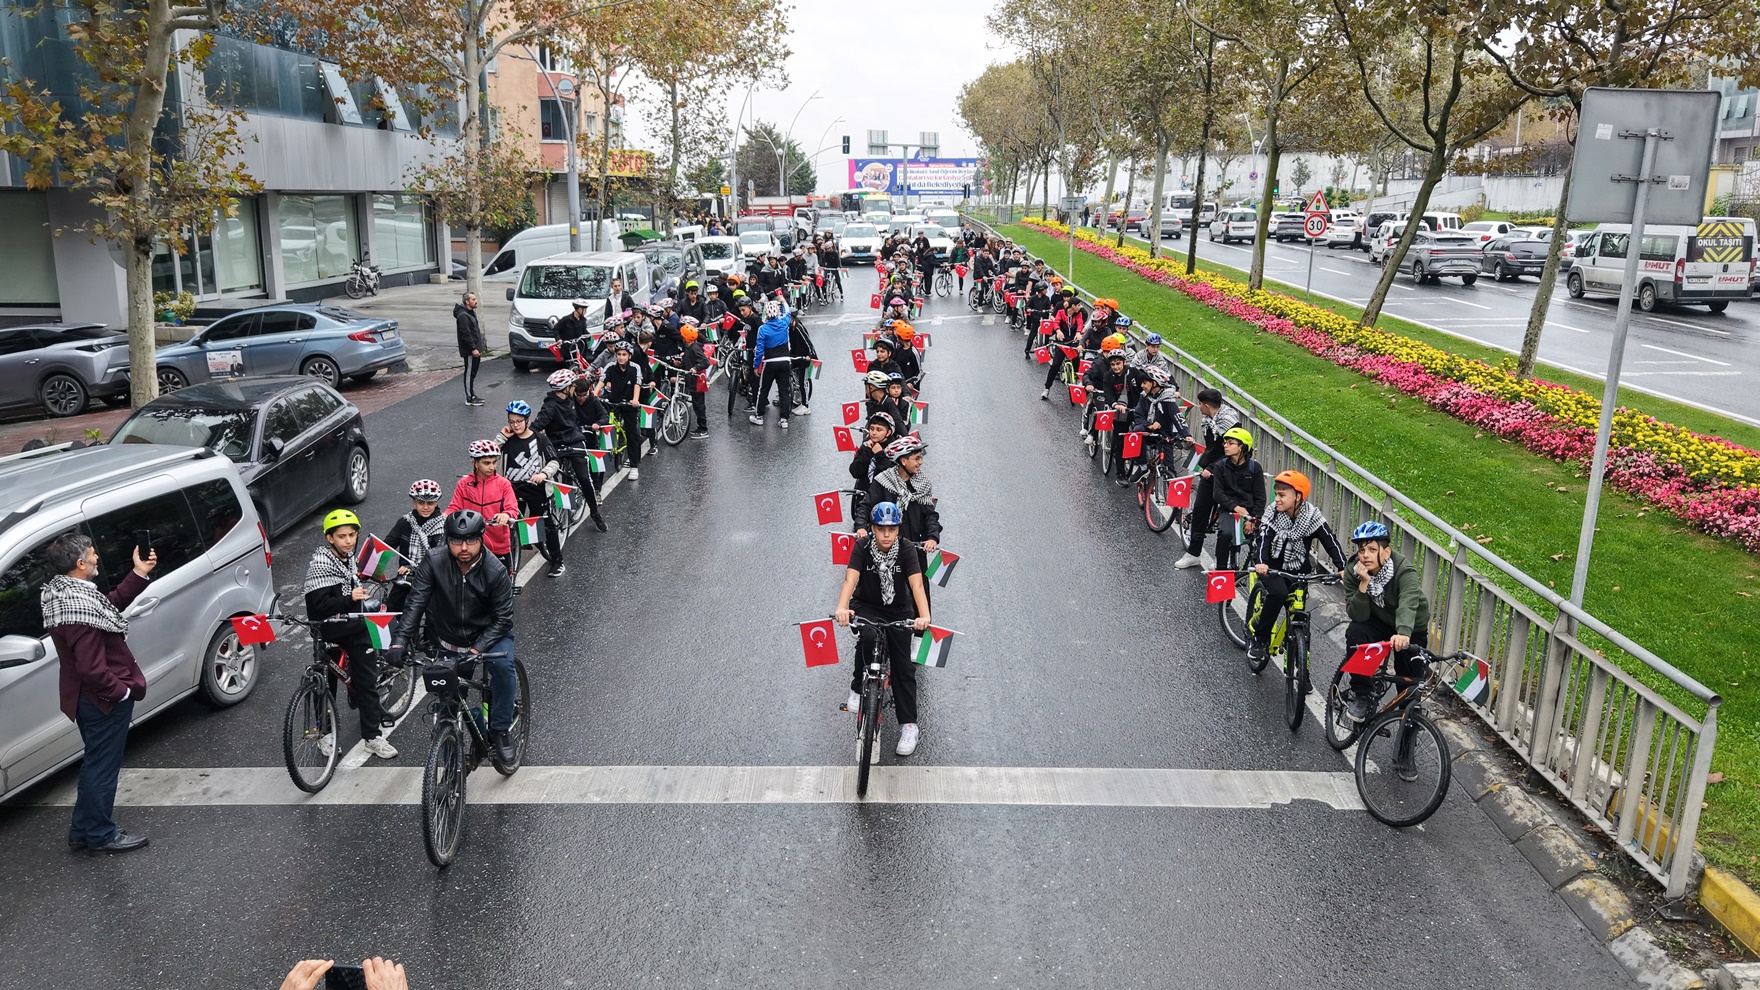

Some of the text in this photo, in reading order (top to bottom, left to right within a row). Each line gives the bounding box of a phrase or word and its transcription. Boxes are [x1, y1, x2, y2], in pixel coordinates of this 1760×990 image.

[611, 153, 643, 173] FOTO
[1309, 220, 1323, 231] 30
[1698, 238, 1742, 248] OKUL TAŞITI
